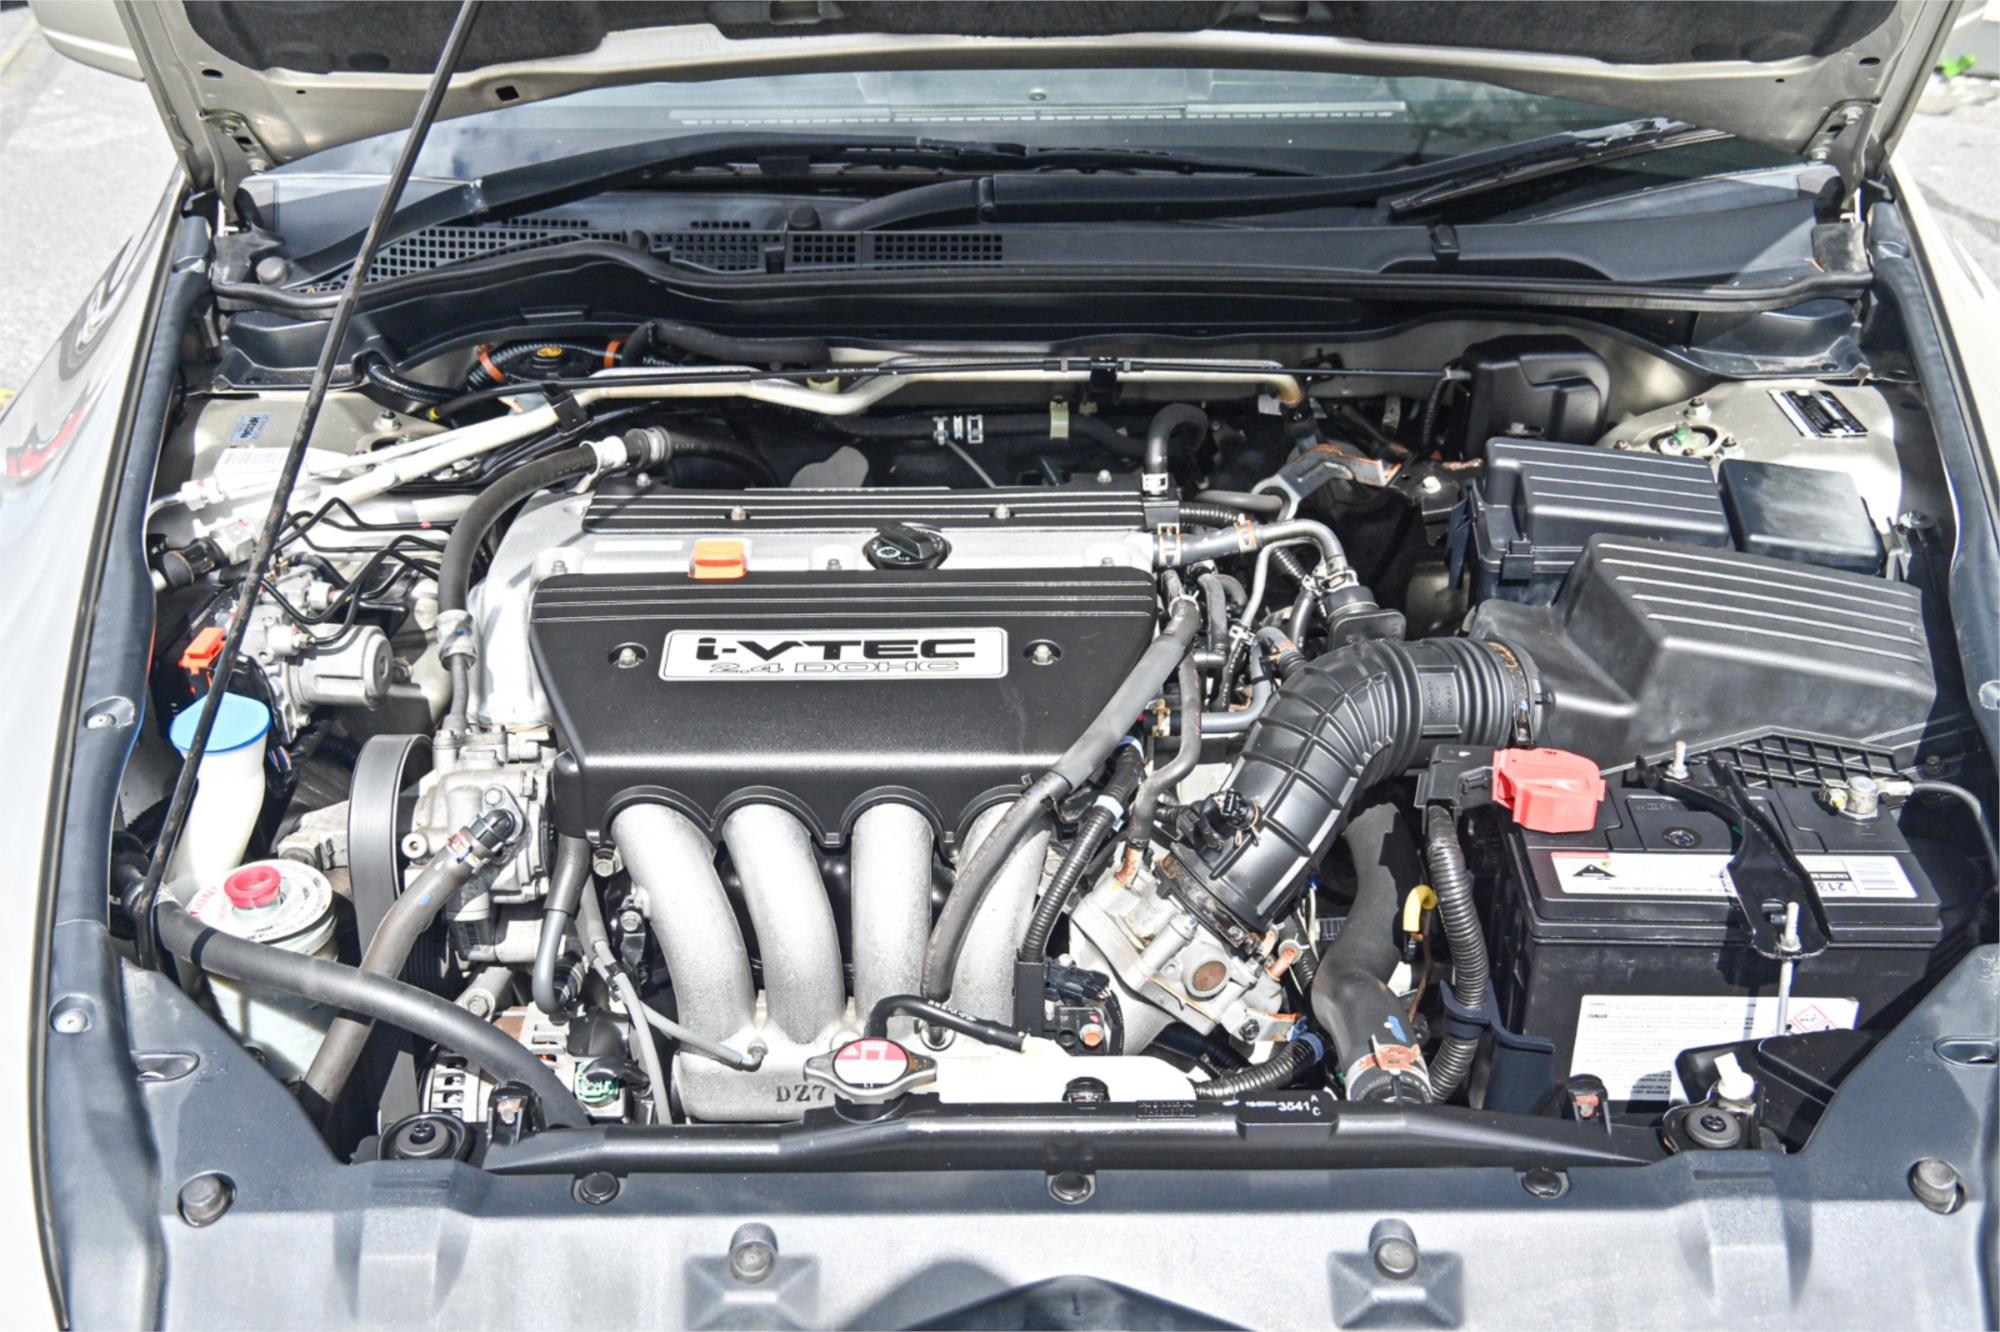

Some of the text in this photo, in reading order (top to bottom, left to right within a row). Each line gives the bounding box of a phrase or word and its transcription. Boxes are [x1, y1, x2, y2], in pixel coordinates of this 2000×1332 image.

[696, 637, 976, 661] i-VTEC
[709, 660, 960, 673] 2.4 DOHC
[776, 1085, 826, 1102] DZ7
